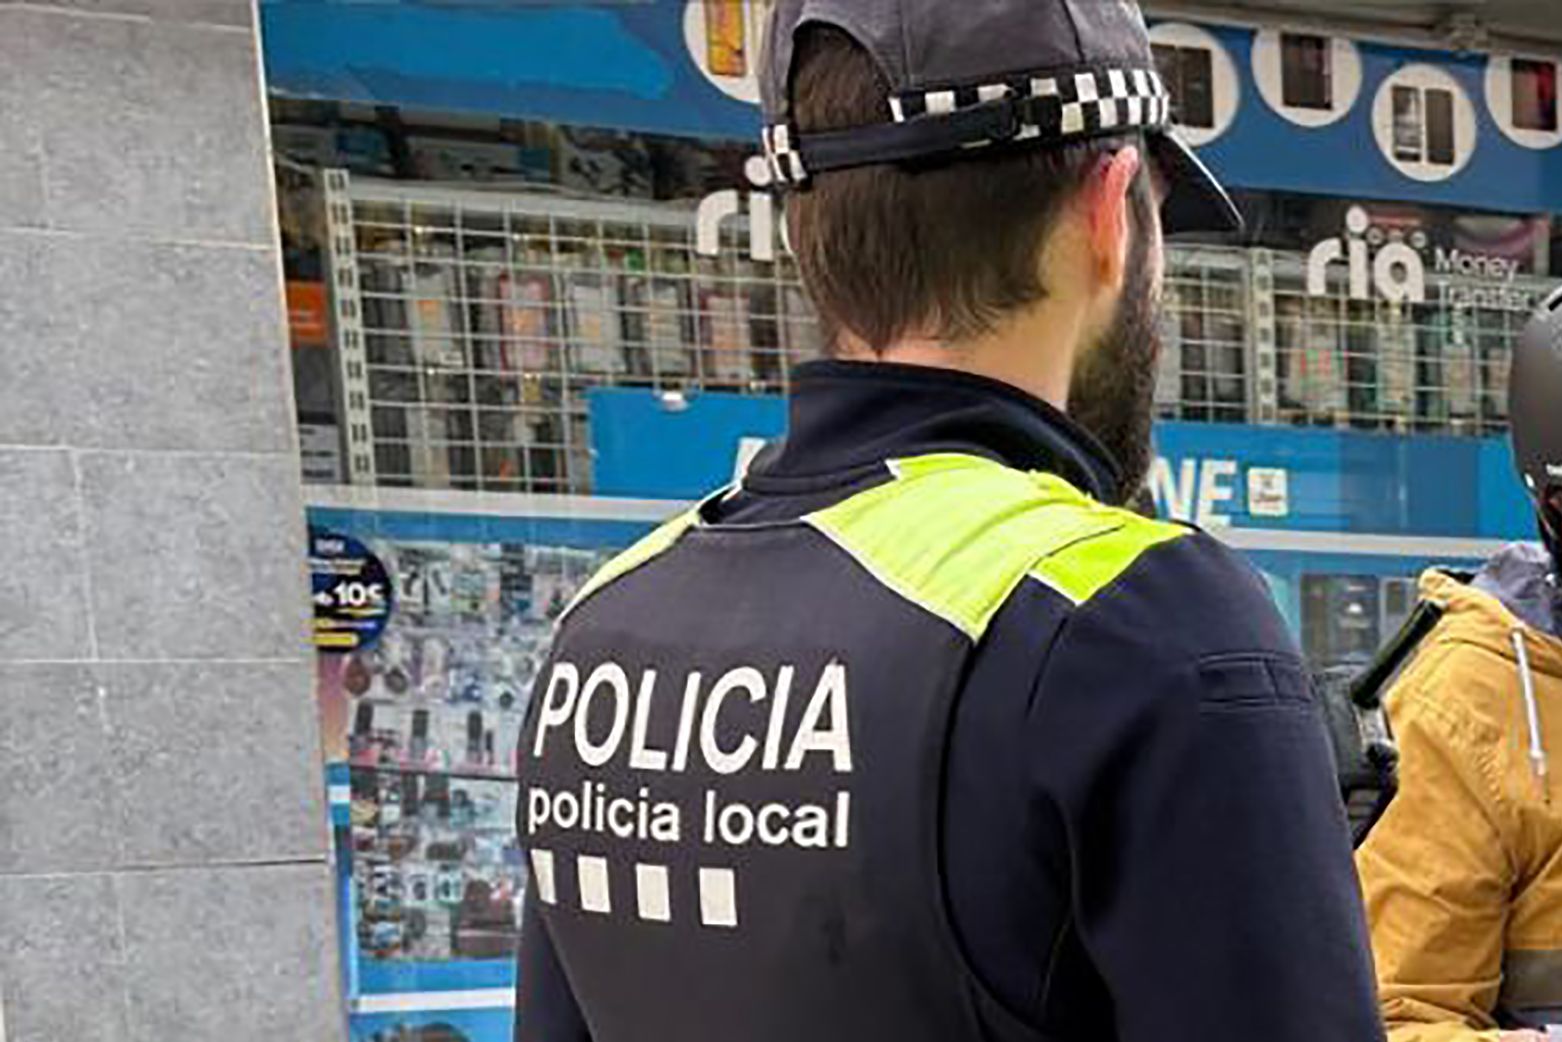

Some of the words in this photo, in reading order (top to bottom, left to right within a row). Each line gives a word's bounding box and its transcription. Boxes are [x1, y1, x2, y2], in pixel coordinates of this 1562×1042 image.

[697, 155, 792, 260] ri
[1307, 205, 1424, 303] ria
[1434, 246, 1518, 281] Money
[532, 658, 853, 774] POLICIA
[527, 781, 681, 842] policia
[703, 790, 851, 848] local
